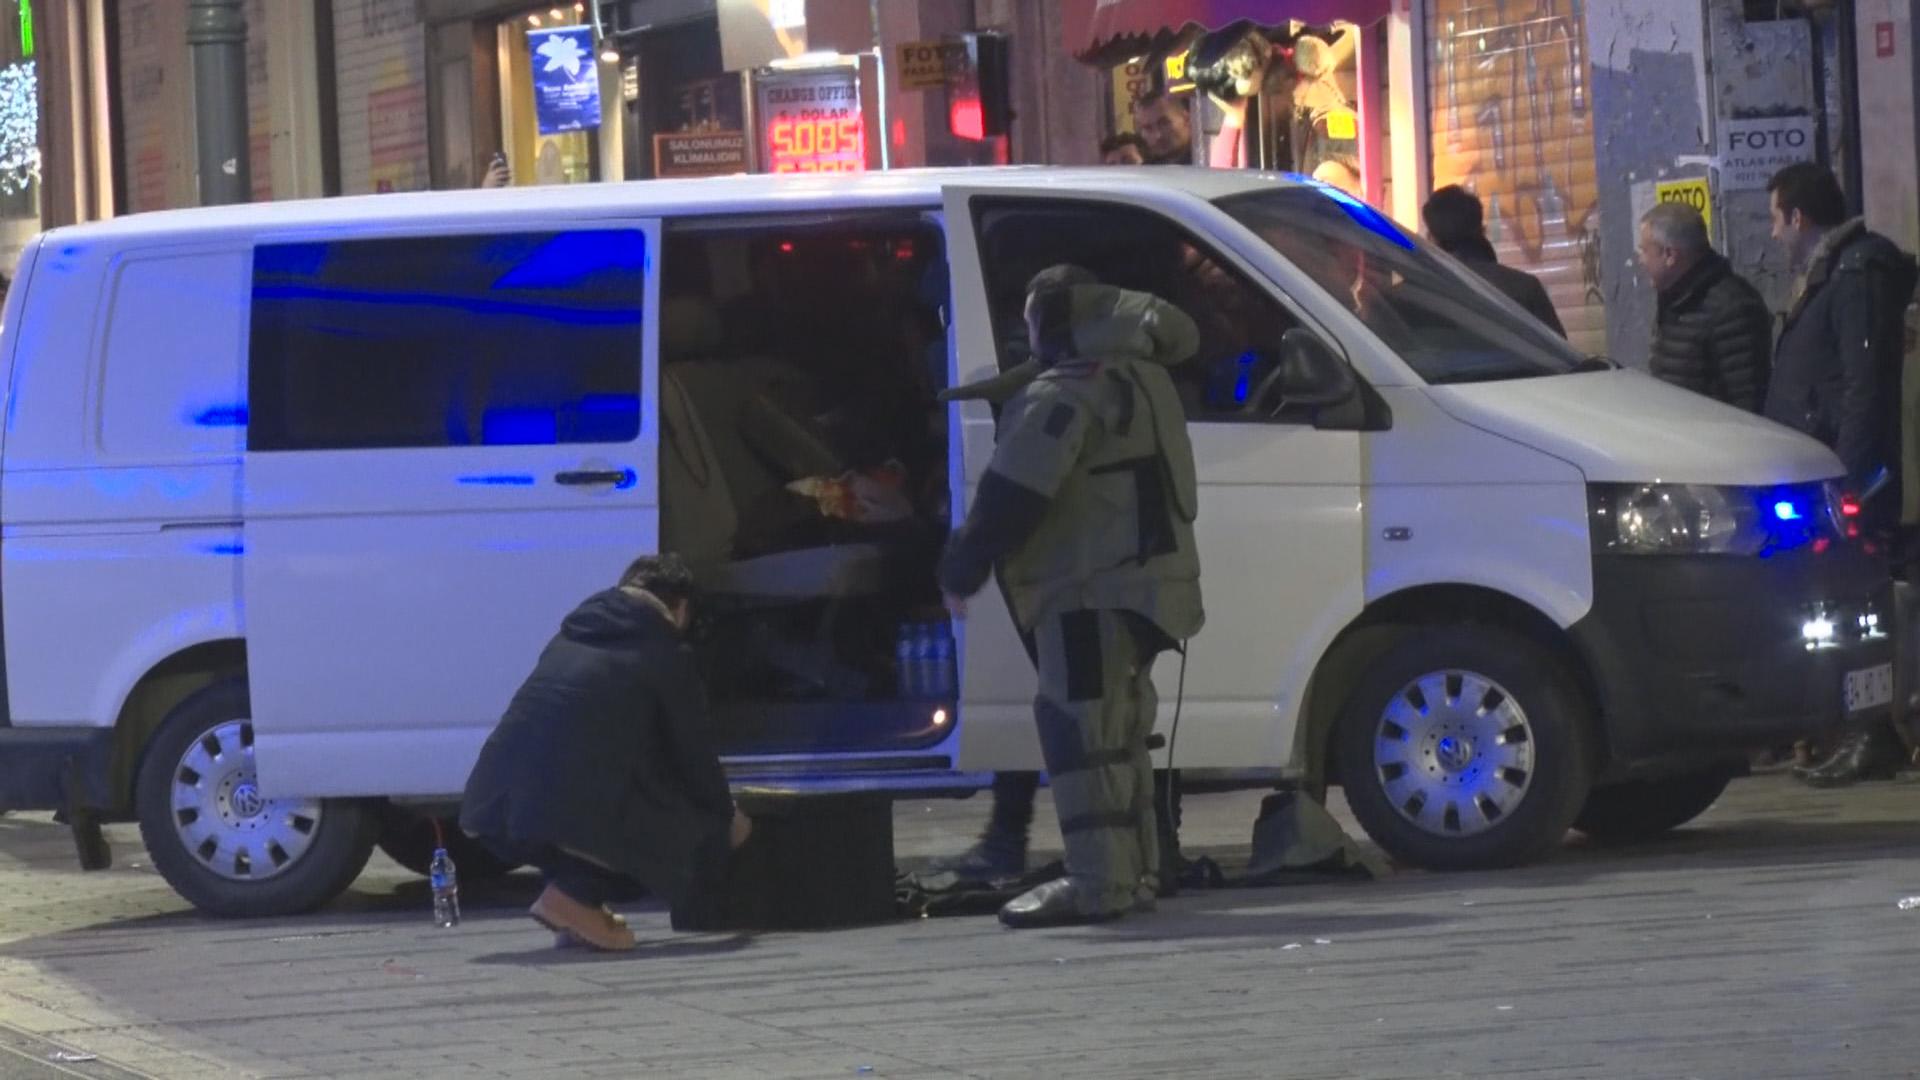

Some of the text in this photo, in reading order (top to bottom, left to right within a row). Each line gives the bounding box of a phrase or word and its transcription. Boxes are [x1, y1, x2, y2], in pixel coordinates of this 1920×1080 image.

[768, 87, 816, 103] CHANGE
[801, 108, 849, 121] DOLAR
[1729, 129, 1805, 151] FOTO
[1724, 157, 1766, 168] ATLAS
